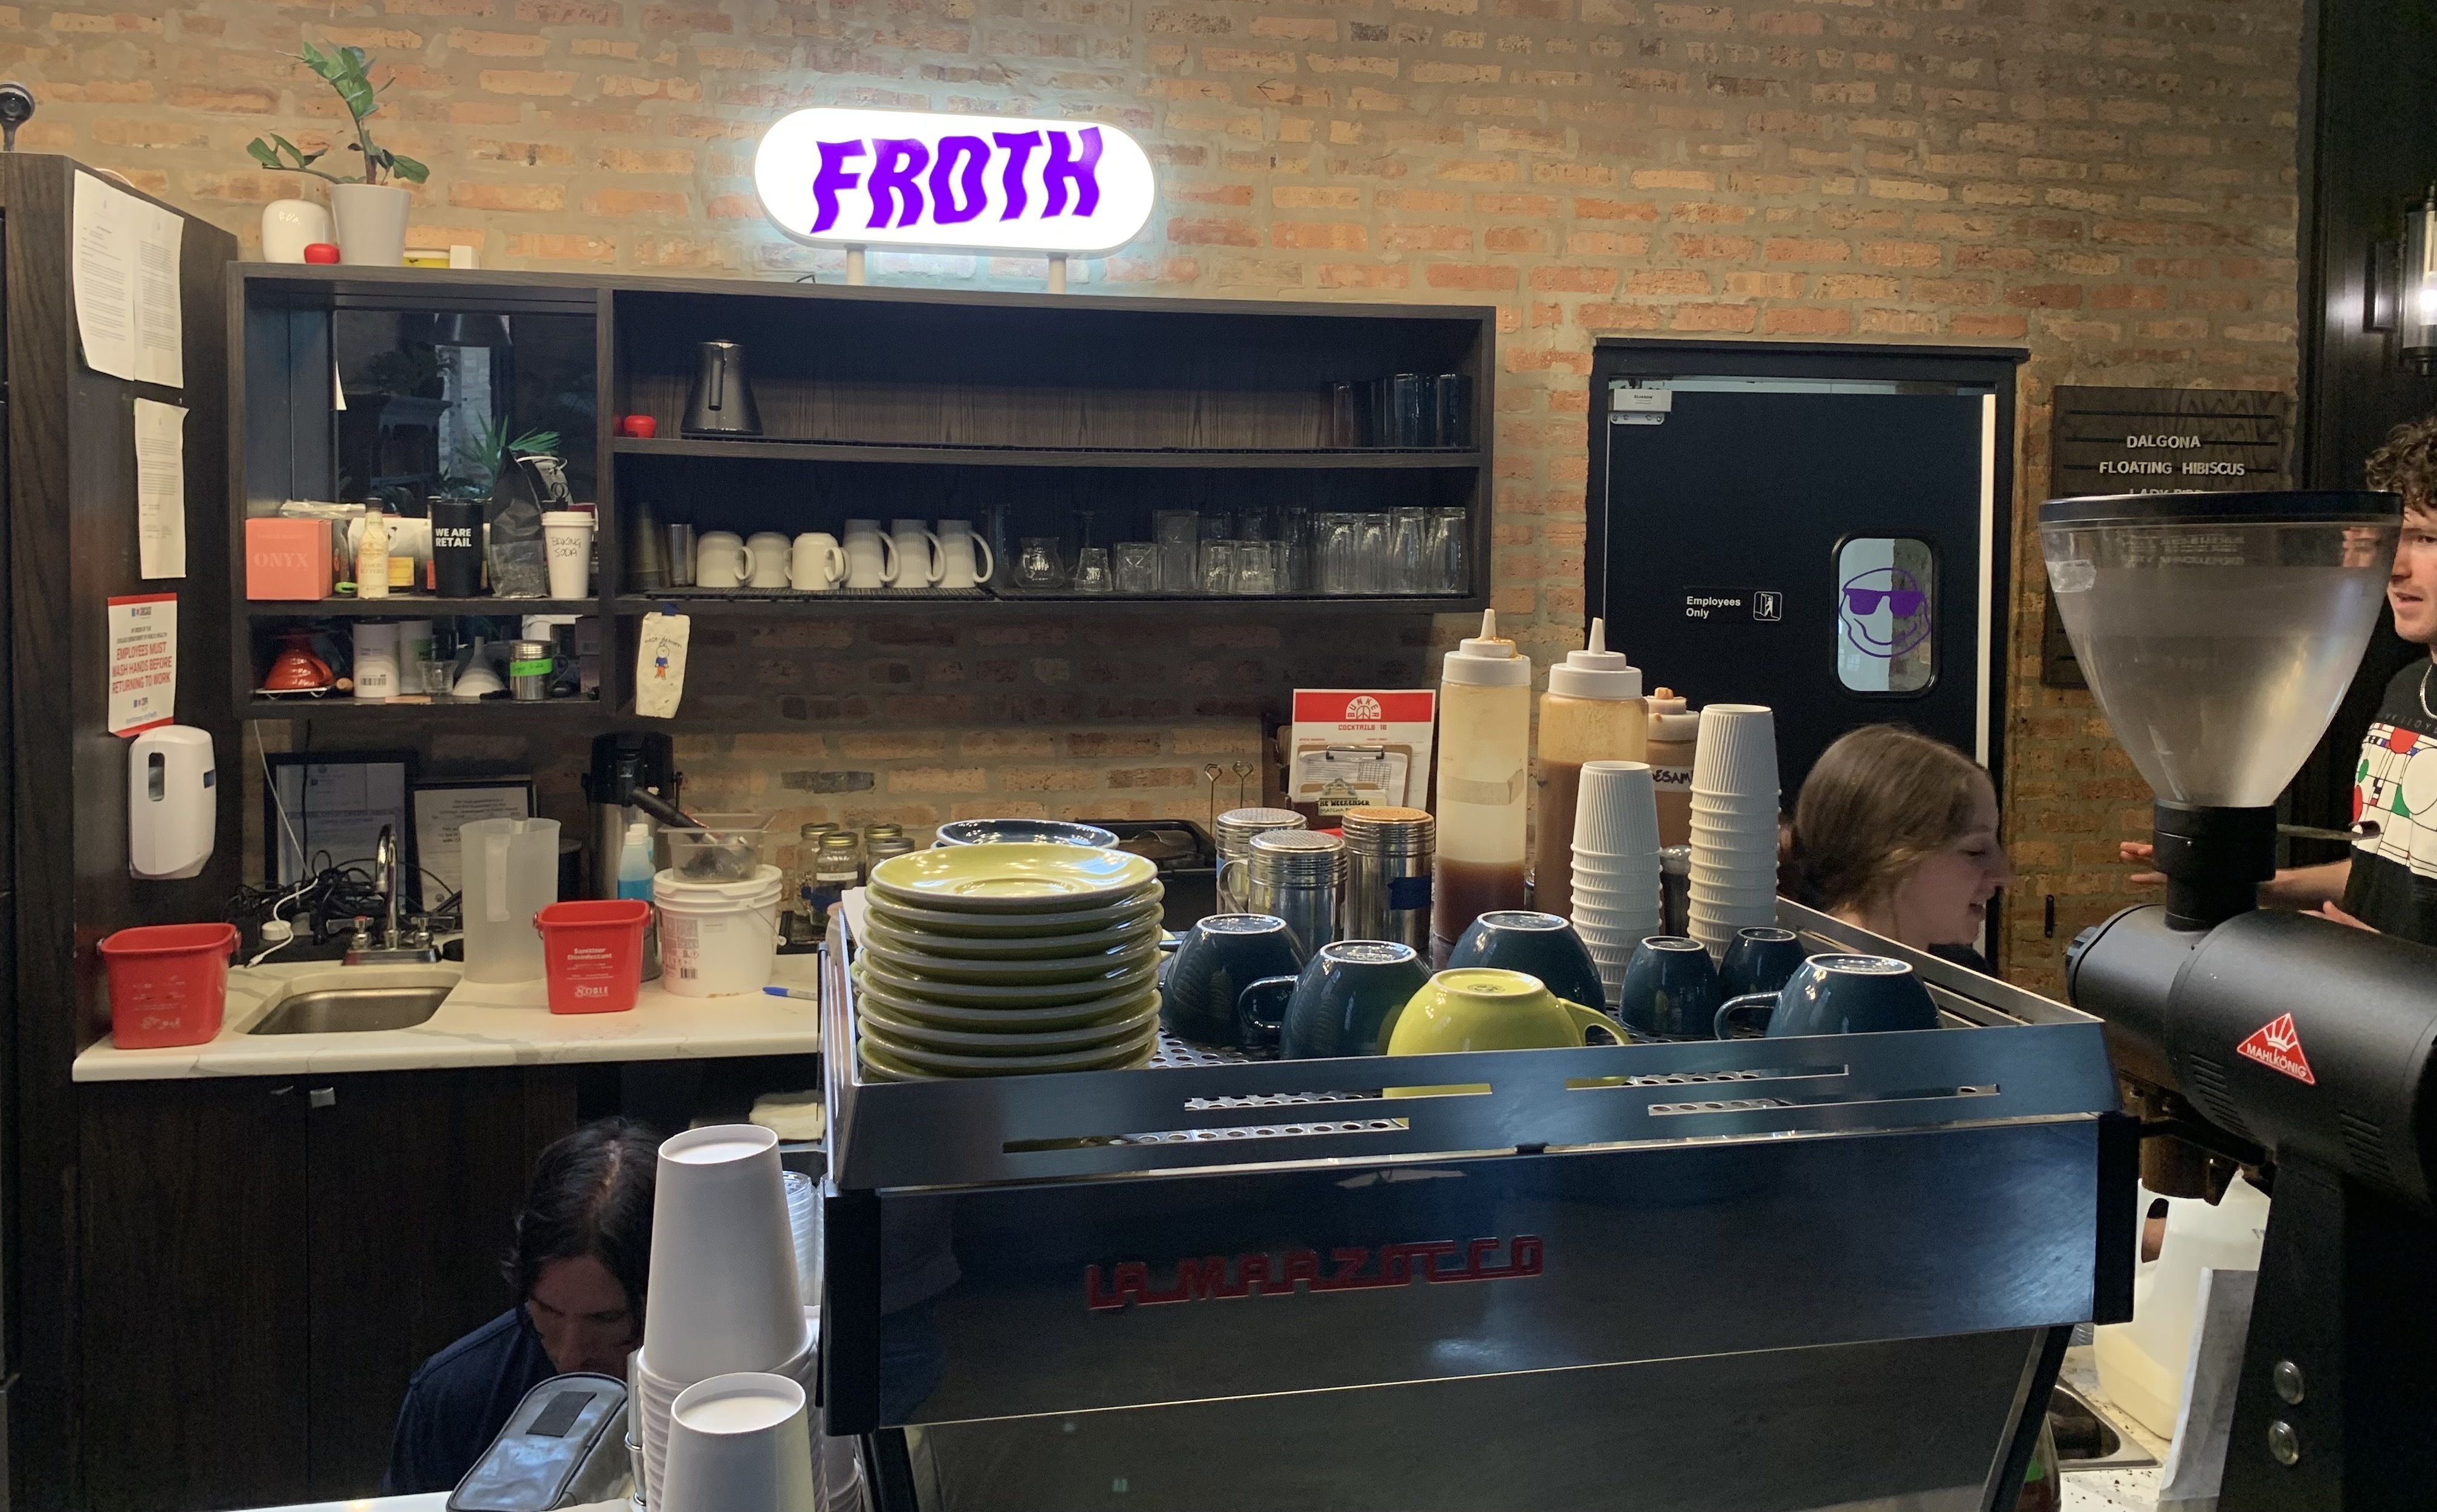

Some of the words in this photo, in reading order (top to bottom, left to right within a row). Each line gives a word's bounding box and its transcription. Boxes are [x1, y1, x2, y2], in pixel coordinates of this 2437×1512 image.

[810, 126, 1104, 234] FROTH
[2126, 435, 2201, 448] DALGONA
[2099, 460, 2172, 474] FLOATING
[2182, 462, 2245, 476] HIBISCUS
[435, 528, 449, 537] WE
[451, 528, 471, 537] ARE
[435, 537, 471, 548] RETAIL
[551, 537, 581, 549] BAKING
[254, 552, 309, 567] ONYX
[554, 548, 578, 557] SODA
[1686, 596, 1741, 607] Employees
[1686, 608, 1709, 619] Only
[117, 644, 149, 660] EMPLOYEES
[149, 641, 167, 655] MUST
[112, 664, 128, 677] WASH
[129, 661, 149, 674] HANDS
[150, 656, 172, 671] BEFORE
[112, 677, 144, 694] RETURNING
[145, 675, 152, 687] TO
[153, 671, 171, 685] WORK
[1347, 697, 1379, 717] BUNKER
[1652, 769, 1693, 784] ESAM
